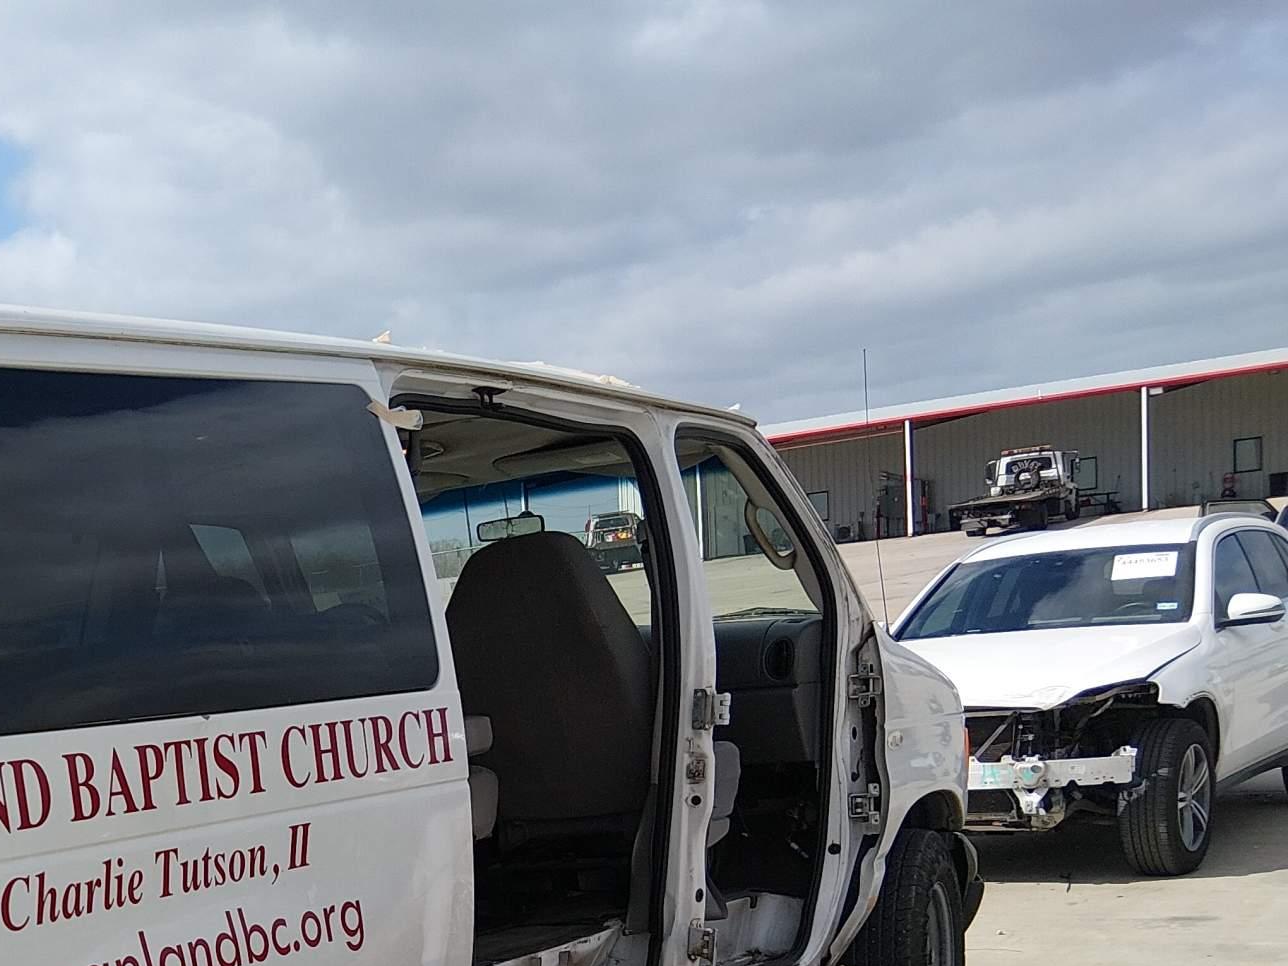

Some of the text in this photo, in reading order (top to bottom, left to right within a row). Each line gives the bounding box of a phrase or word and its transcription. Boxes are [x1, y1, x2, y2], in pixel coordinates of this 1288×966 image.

[62, 730, 267, 822] BAPTIST
[280, 707, 454, 788] CHURCH
[0, 858, 144, 932] Charlie
[155, 844, 280, 899] Tutson,
